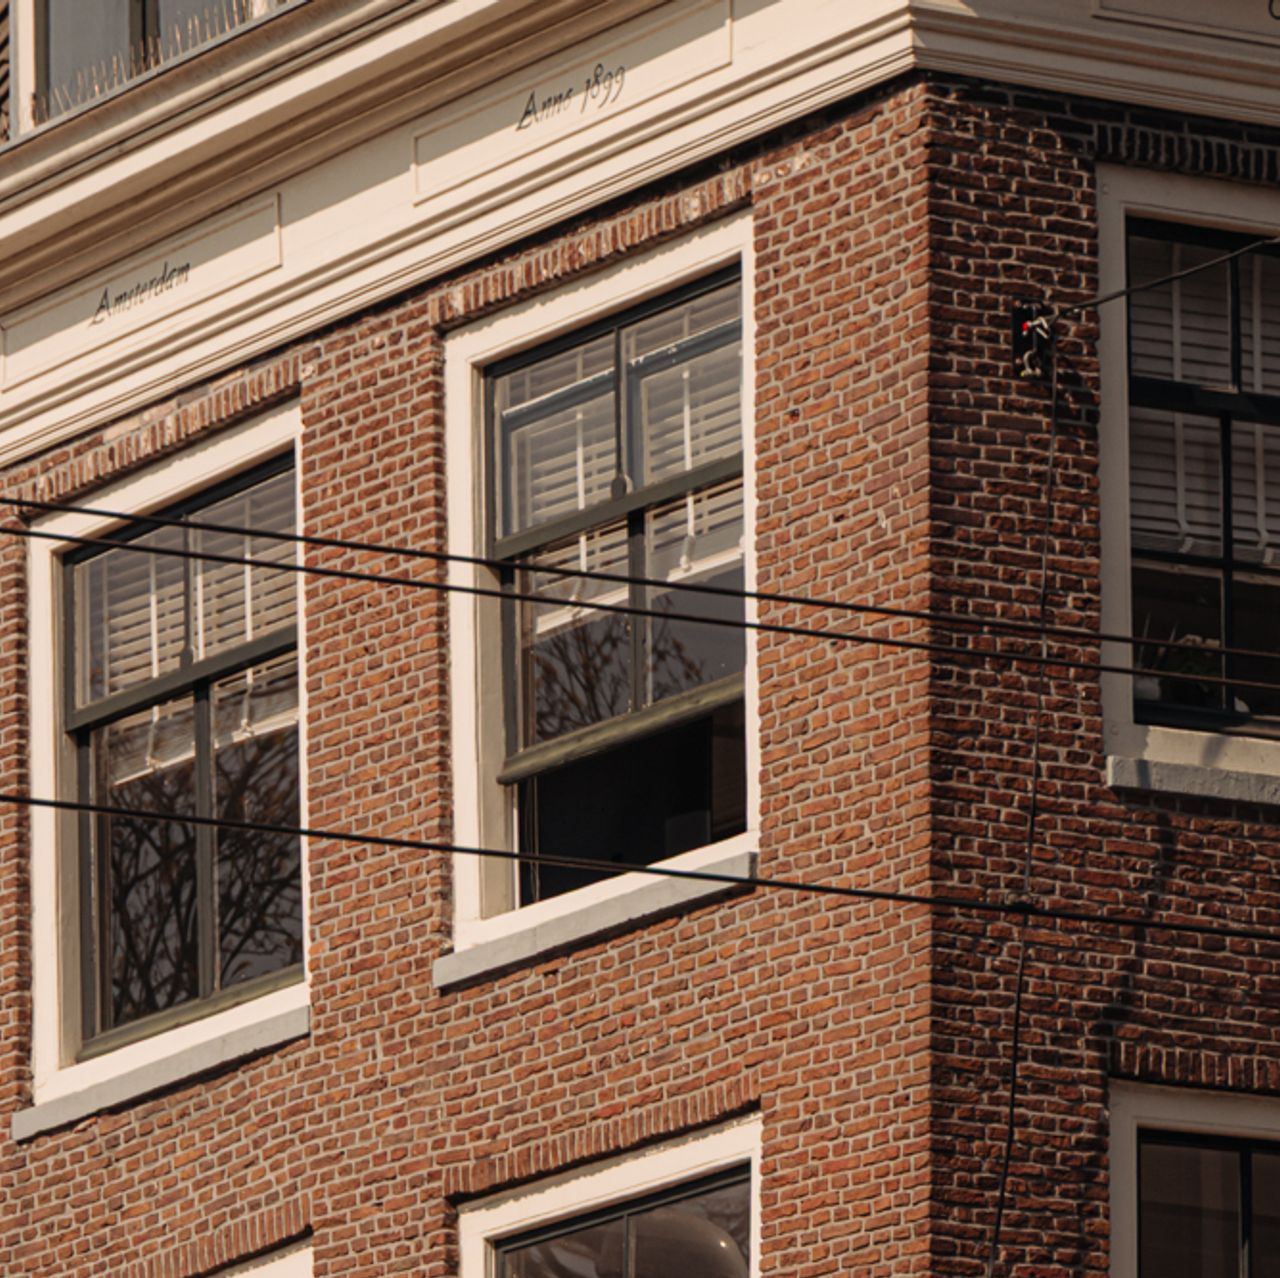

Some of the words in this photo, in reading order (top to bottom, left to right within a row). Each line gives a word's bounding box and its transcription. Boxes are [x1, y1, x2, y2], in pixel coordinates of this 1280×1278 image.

[88, 260, 190, 328] Amsterdam
[516, 88, 574, 131] Anno
[581, 63, 625, 114] 1899
